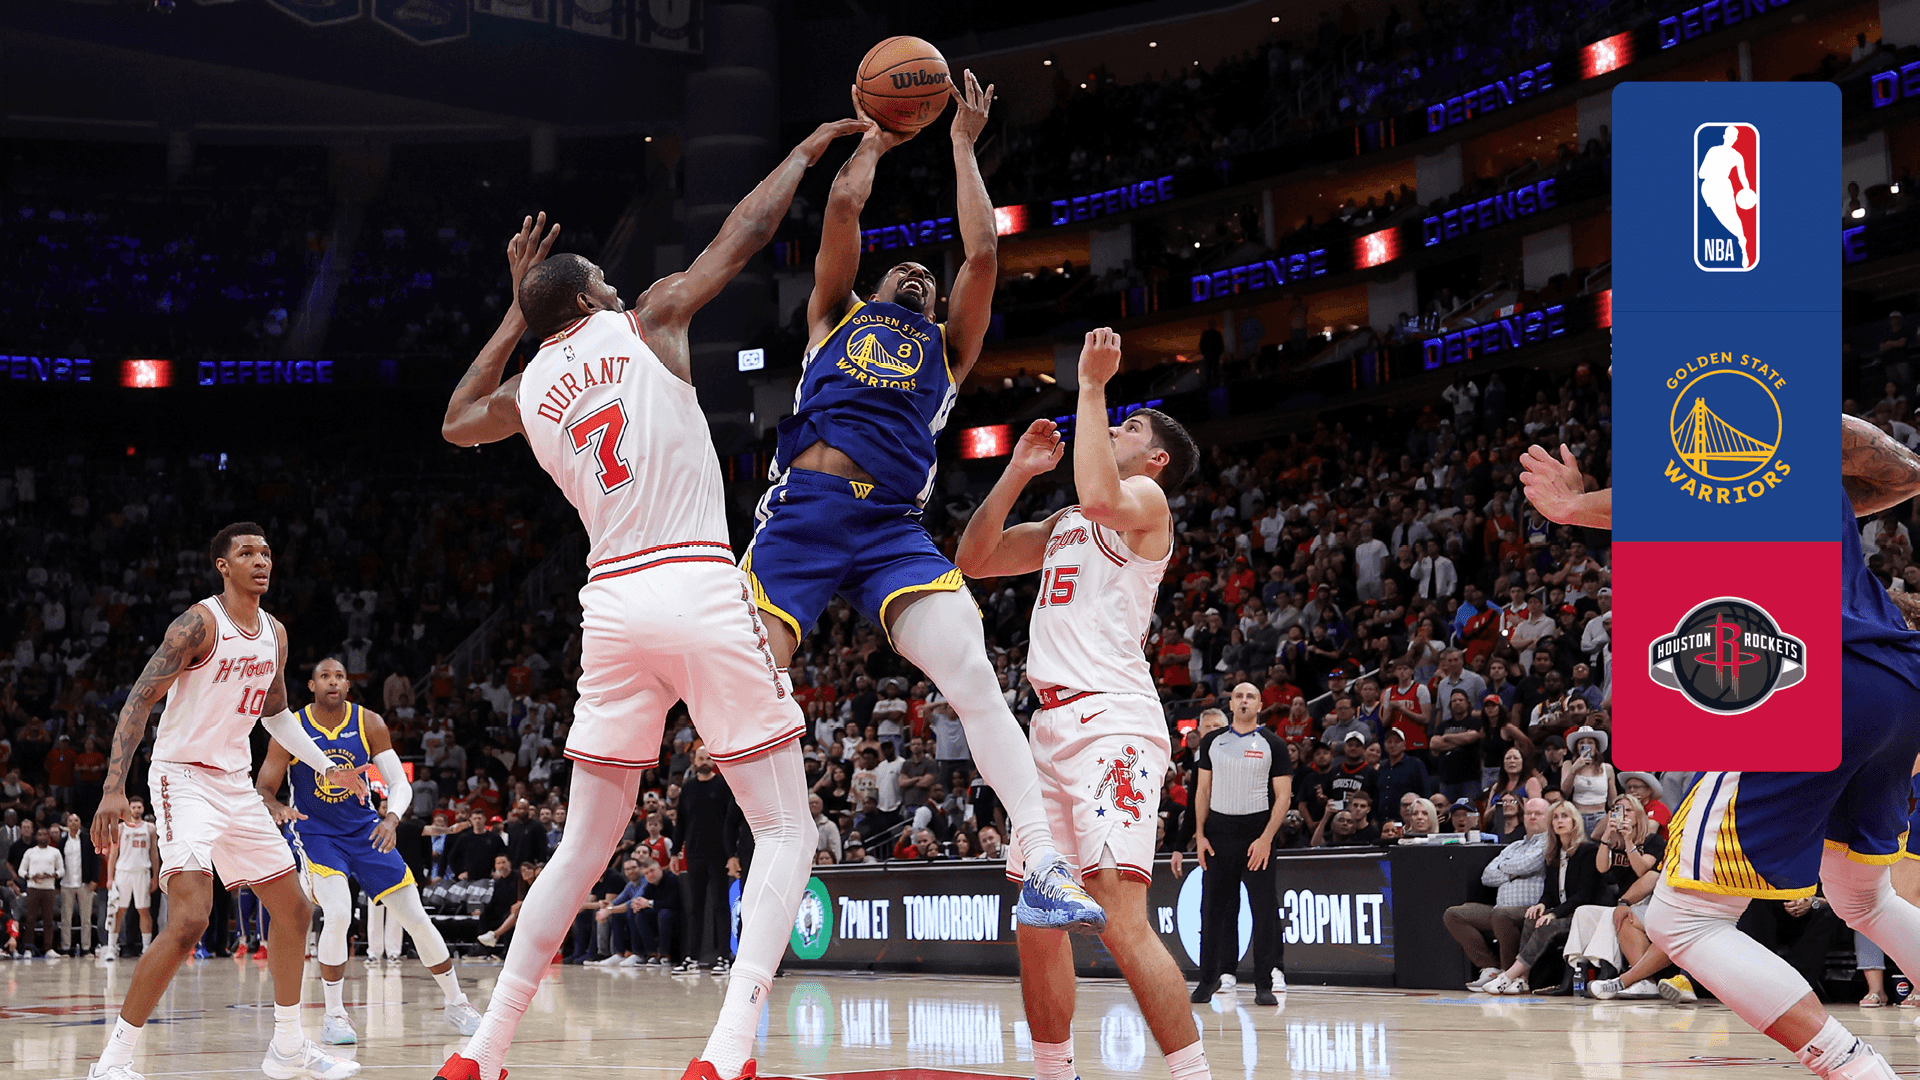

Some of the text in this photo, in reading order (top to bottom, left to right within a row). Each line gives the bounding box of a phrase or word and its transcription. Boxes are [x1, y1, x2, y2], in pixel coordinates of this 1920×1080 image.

[1659, 0, 1788, 49] DEFEN
[1427, 61, 1553, 133] DEFENSE
[1051, 174, 1174, 226] DEFENSE
[1423, 178, 1557, 247] DEFENSE
[861, 216, 953, 253] FENSE
[1191, 248, 1327, 302] DEFENSE
[852, 314, 931, 343] GOLDEN STATE
[897, 343, 913, 359] 8
[1423, 303, 1565, 370] DEFENSE
[199, 360, 334, 385] DEFENSE
[537, 356, 630, 424] DURANT
[836, 356, 917, 391] WARRIORS
[565, 397, 635, 496] 7
[1038, 564, 1081, 610] 15
[212, 654, 275, 684] H-Town
[235, 685, 266, 717] 10
[838, 896, 870, 940] 7PM
[872, 899, 890, 940] ET
[902, 894, 1001, 941] TOMORROW
[1157, 906, 1174, 935] VS
[1355, 893, 1384, 944] ET
